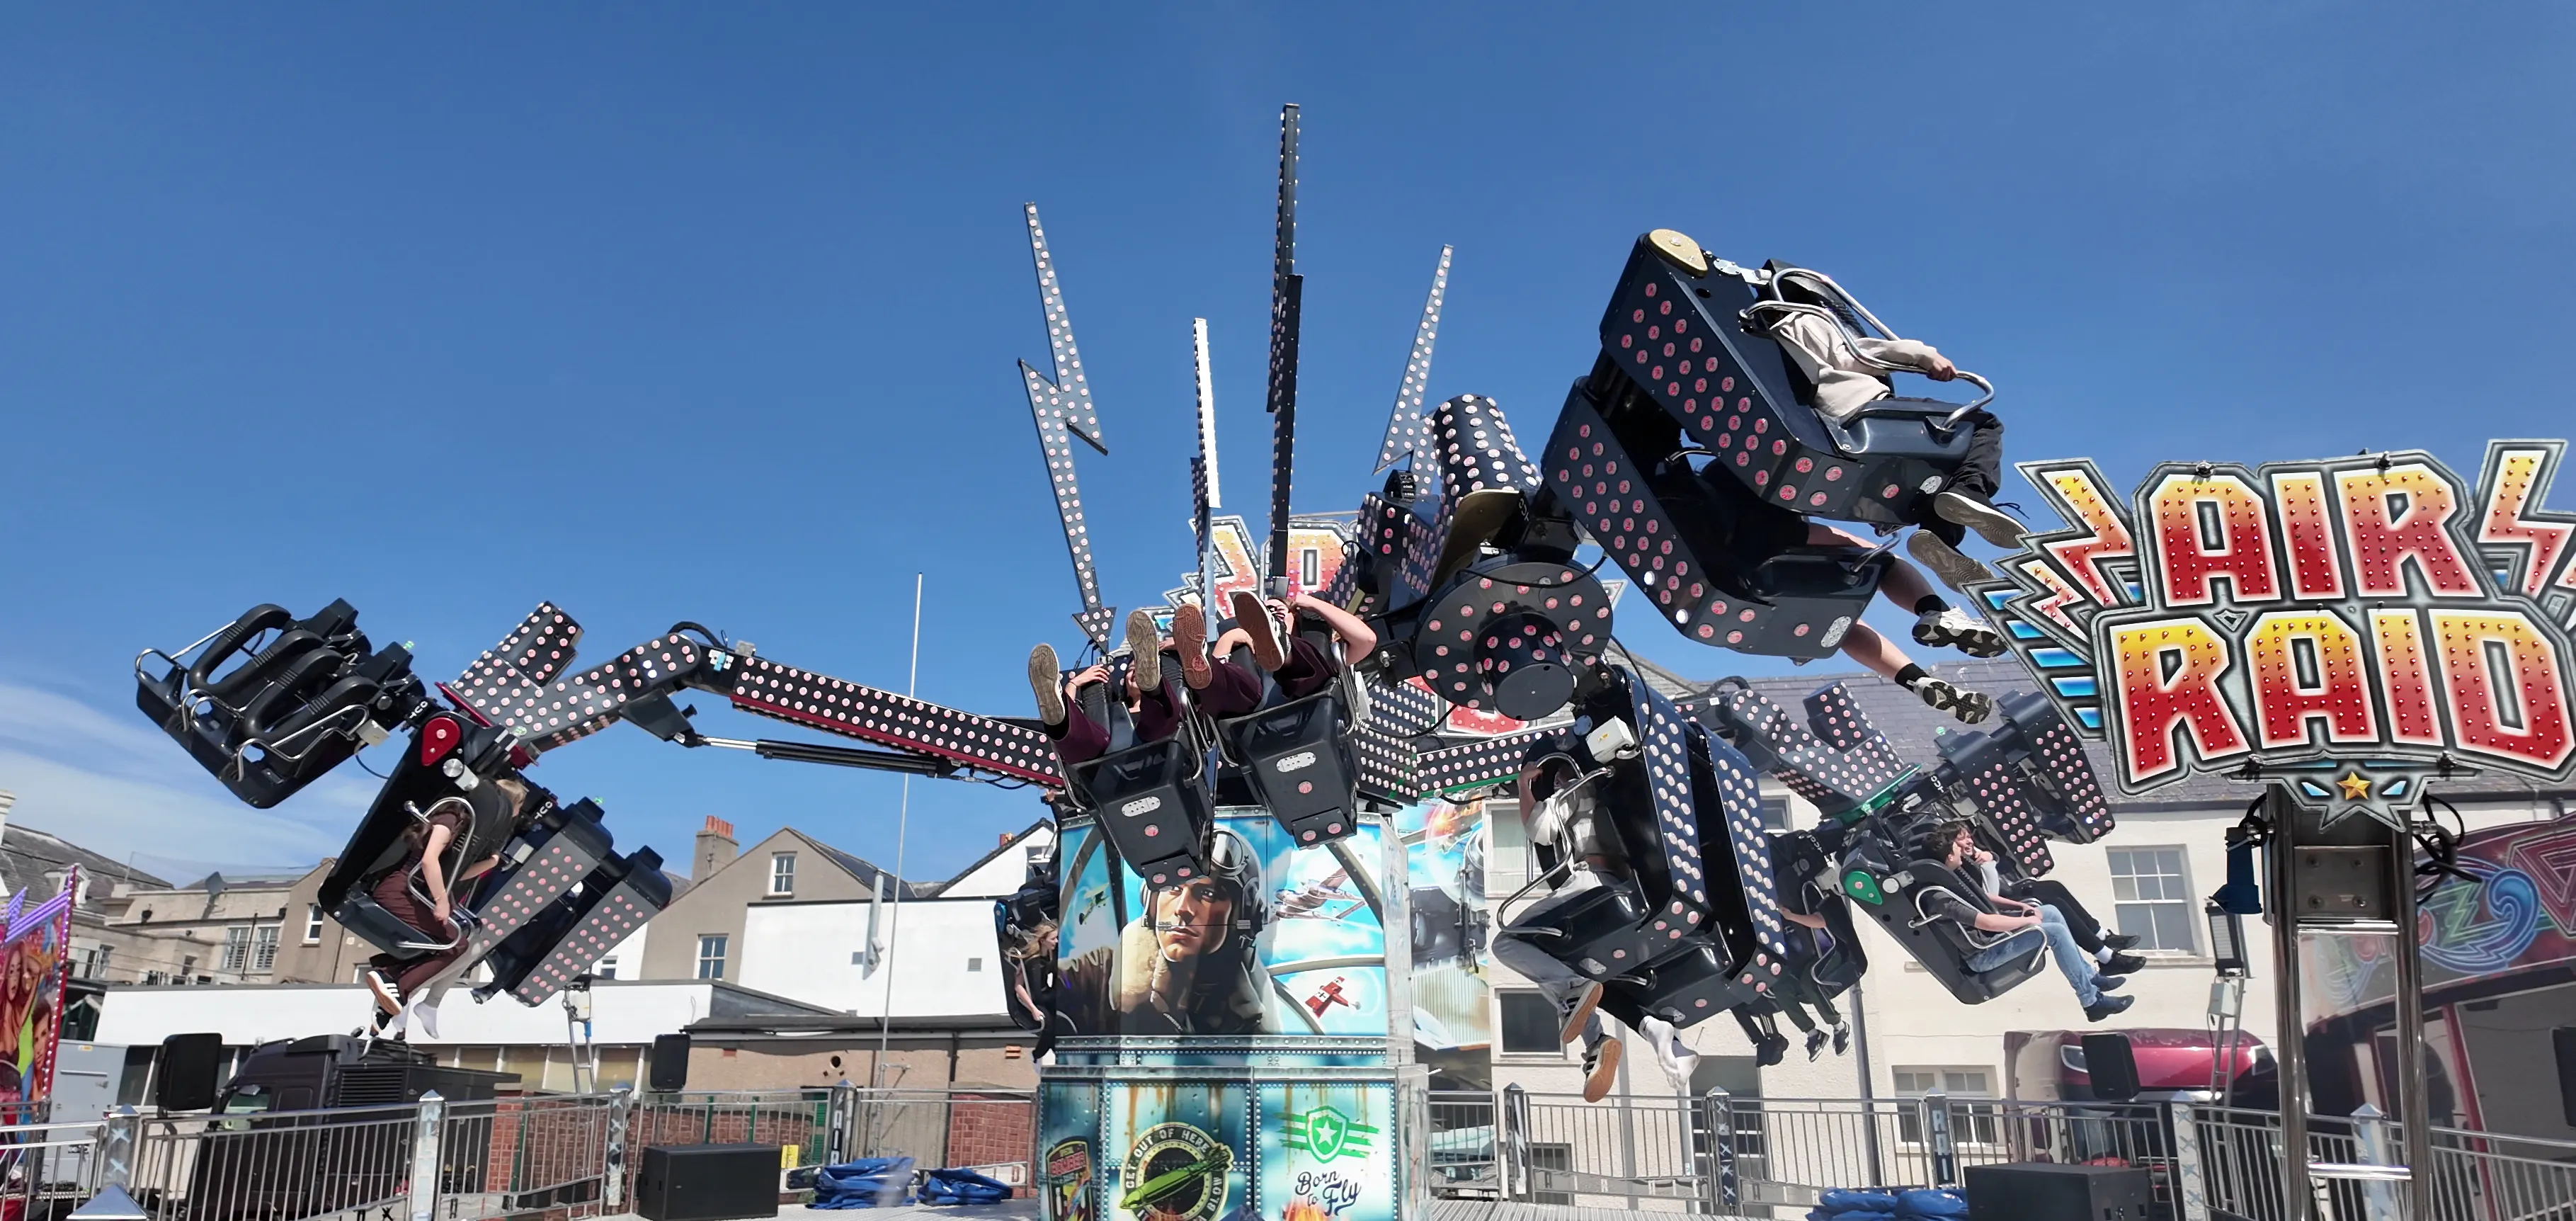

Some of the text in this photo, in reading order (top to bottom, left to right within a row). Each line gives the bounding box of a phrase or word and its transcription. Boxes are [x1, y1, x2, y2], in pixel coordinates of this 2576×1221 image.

[2150, 463, 2485, 608] AIR
[2109, 608, 2575, 783] RAID
[1125, 1128, 1210, 1189] GET OUT OF HERE
[1932, 1109, 1949, 1181] RAI
[1206, 1176, 1224, 1213] BLOW
[1294, 1170, 1341, 1196] Born
[1306, 1179, 1363, 1217] to Fly
